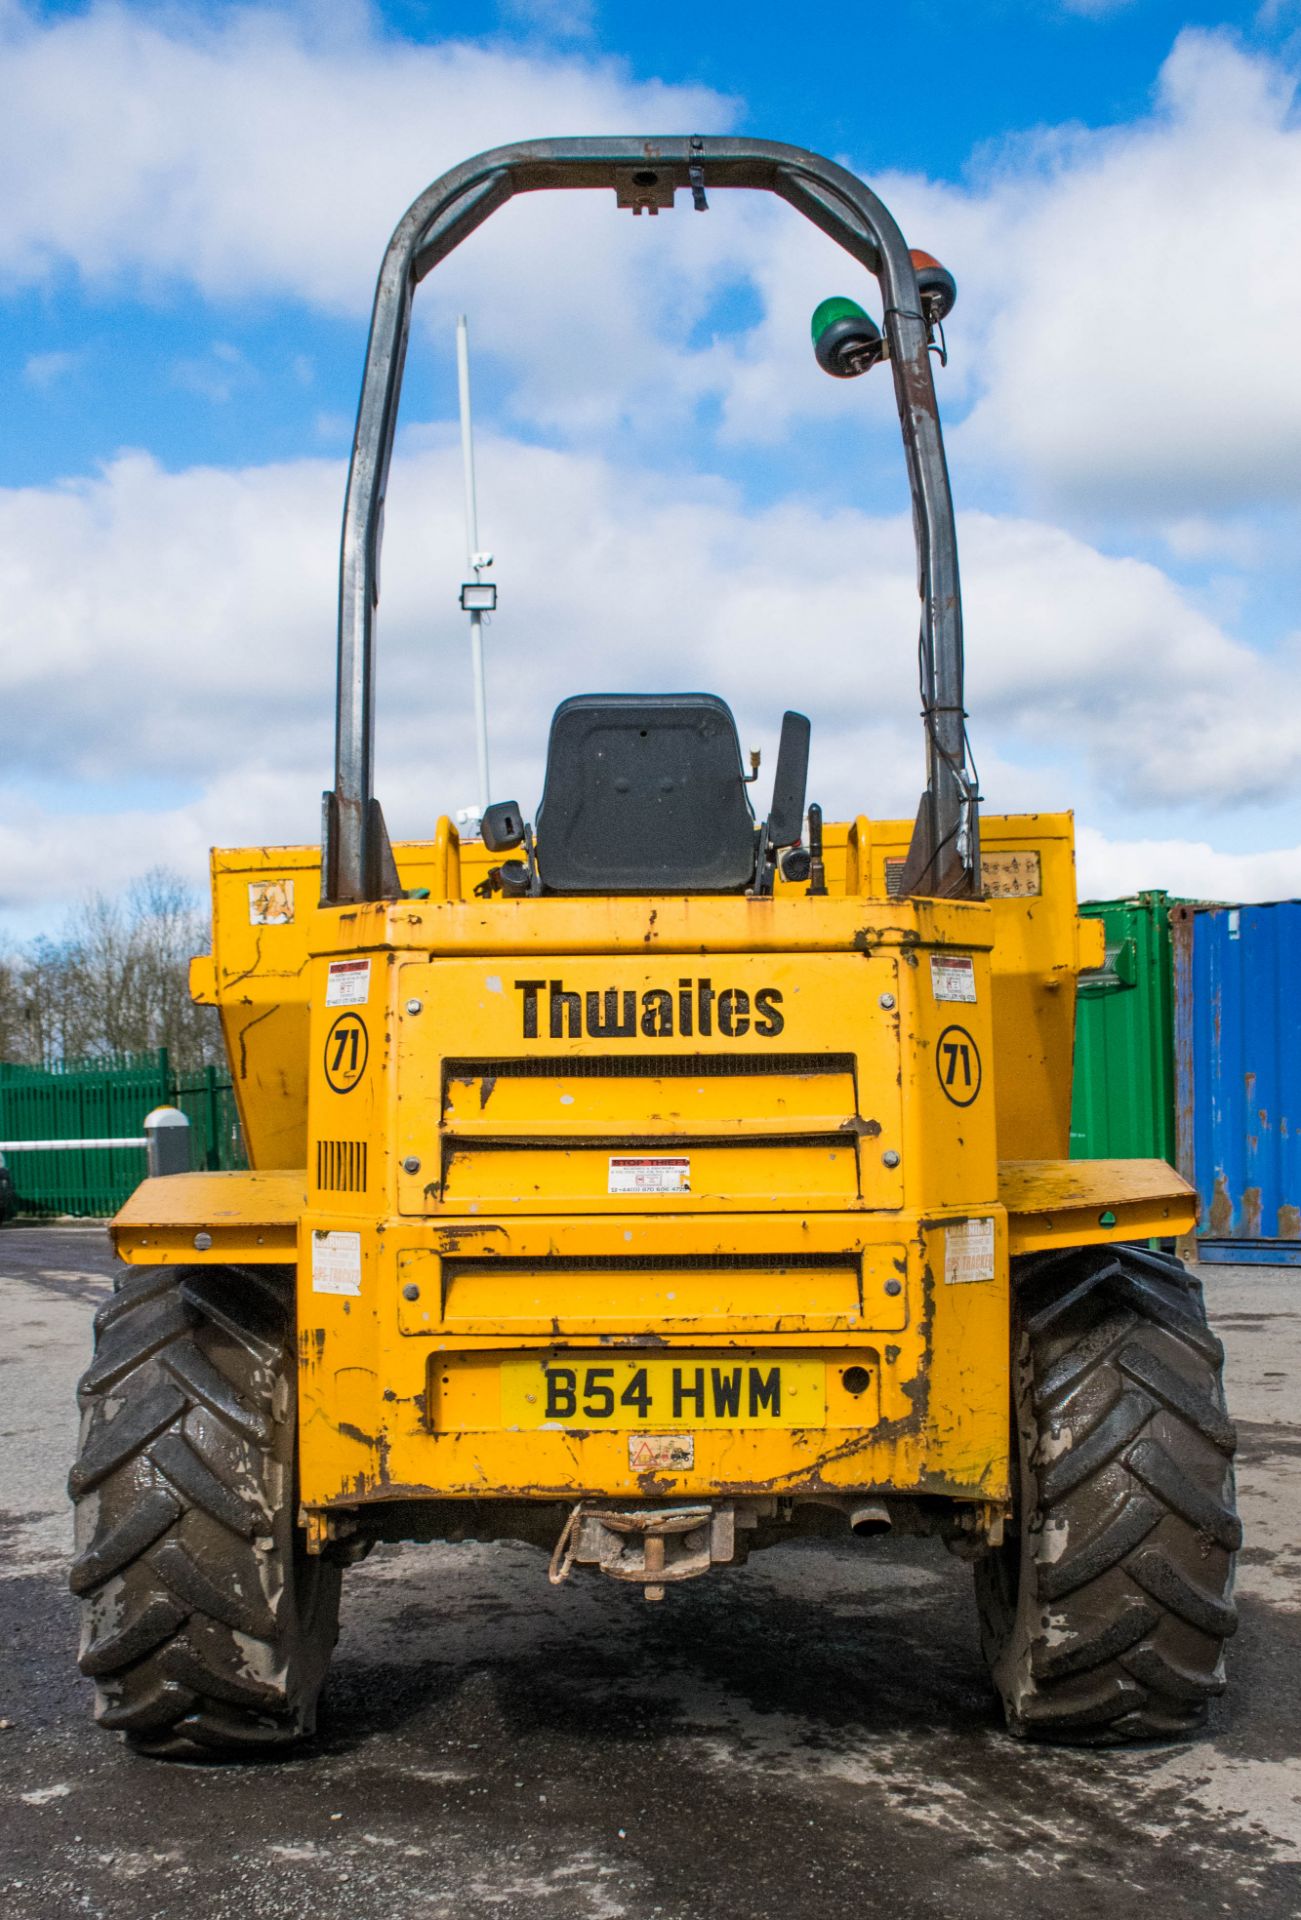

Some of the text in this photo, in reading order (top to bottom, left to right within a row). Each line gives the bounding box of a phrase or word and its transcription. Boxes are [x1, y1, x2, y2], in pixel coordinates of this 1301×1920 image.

[514, 978, 785, 1039] Thwaites
[331, 1029, 360, 1071] 71
[943, 1043, 971, 1086] 71
[544, 1367, 781, 1419] B54 HWM
